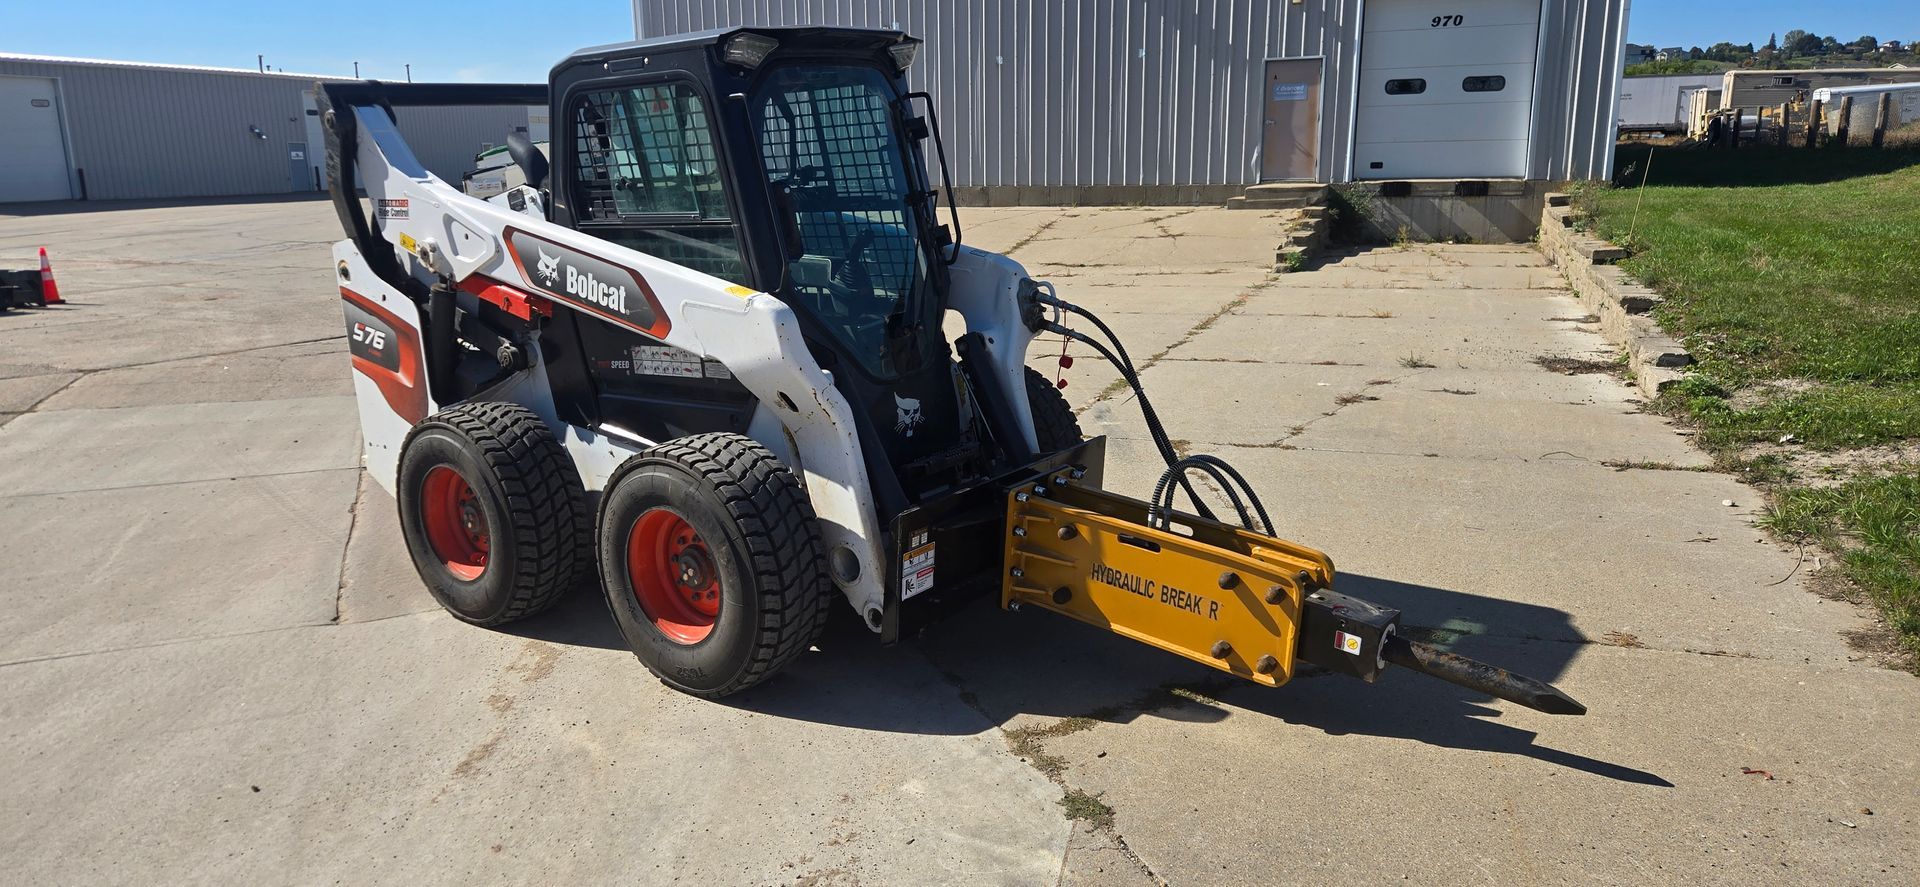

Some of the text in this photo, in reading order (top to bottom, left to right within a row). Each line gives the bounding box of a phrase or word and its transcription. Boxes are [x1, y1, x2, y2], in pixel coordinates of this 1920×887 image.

[1431, 15, 1464, 28] 970
[567, 264, 626, 314] Bobcat
[353, 322, 386, 350] S76
[610, 360, 630, 369] SPEED
[1091, 563, 1155, 599] HYDRAULIC
